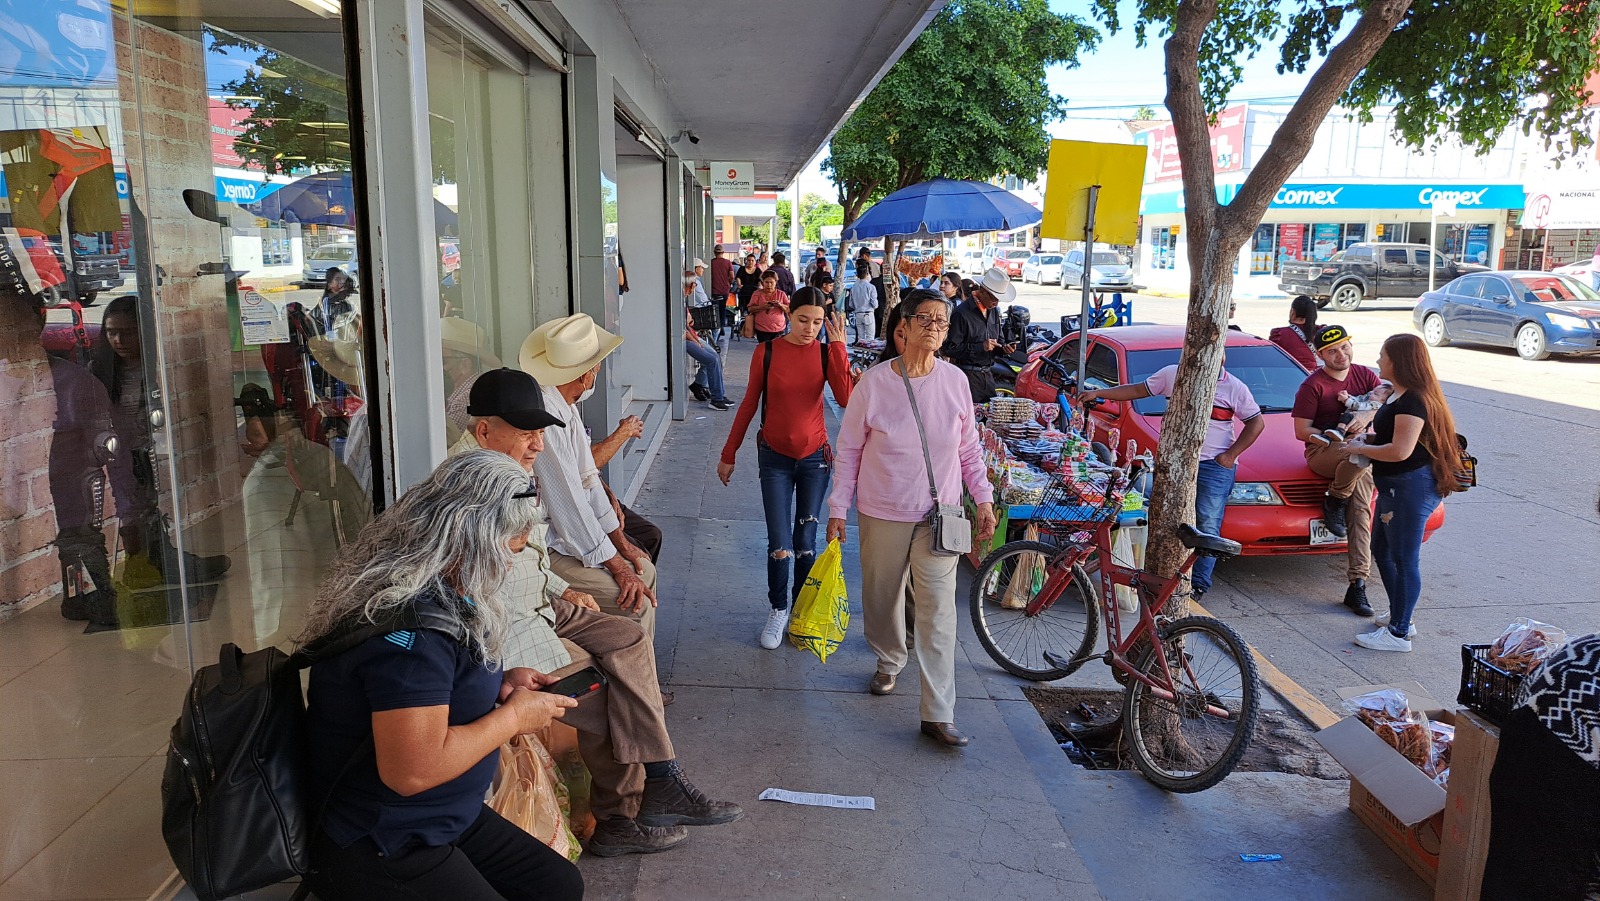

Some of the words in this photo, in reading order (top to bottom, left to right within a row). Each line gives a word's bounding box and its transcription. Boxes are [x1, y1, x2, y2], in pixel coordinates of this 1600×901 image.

[1272, 186, 1344, 205] Comex
[1418, 187, 1489, 205] Comex
[10, 271, 25, 295] FREE
[1103, 573, 1118, 648] TREK
